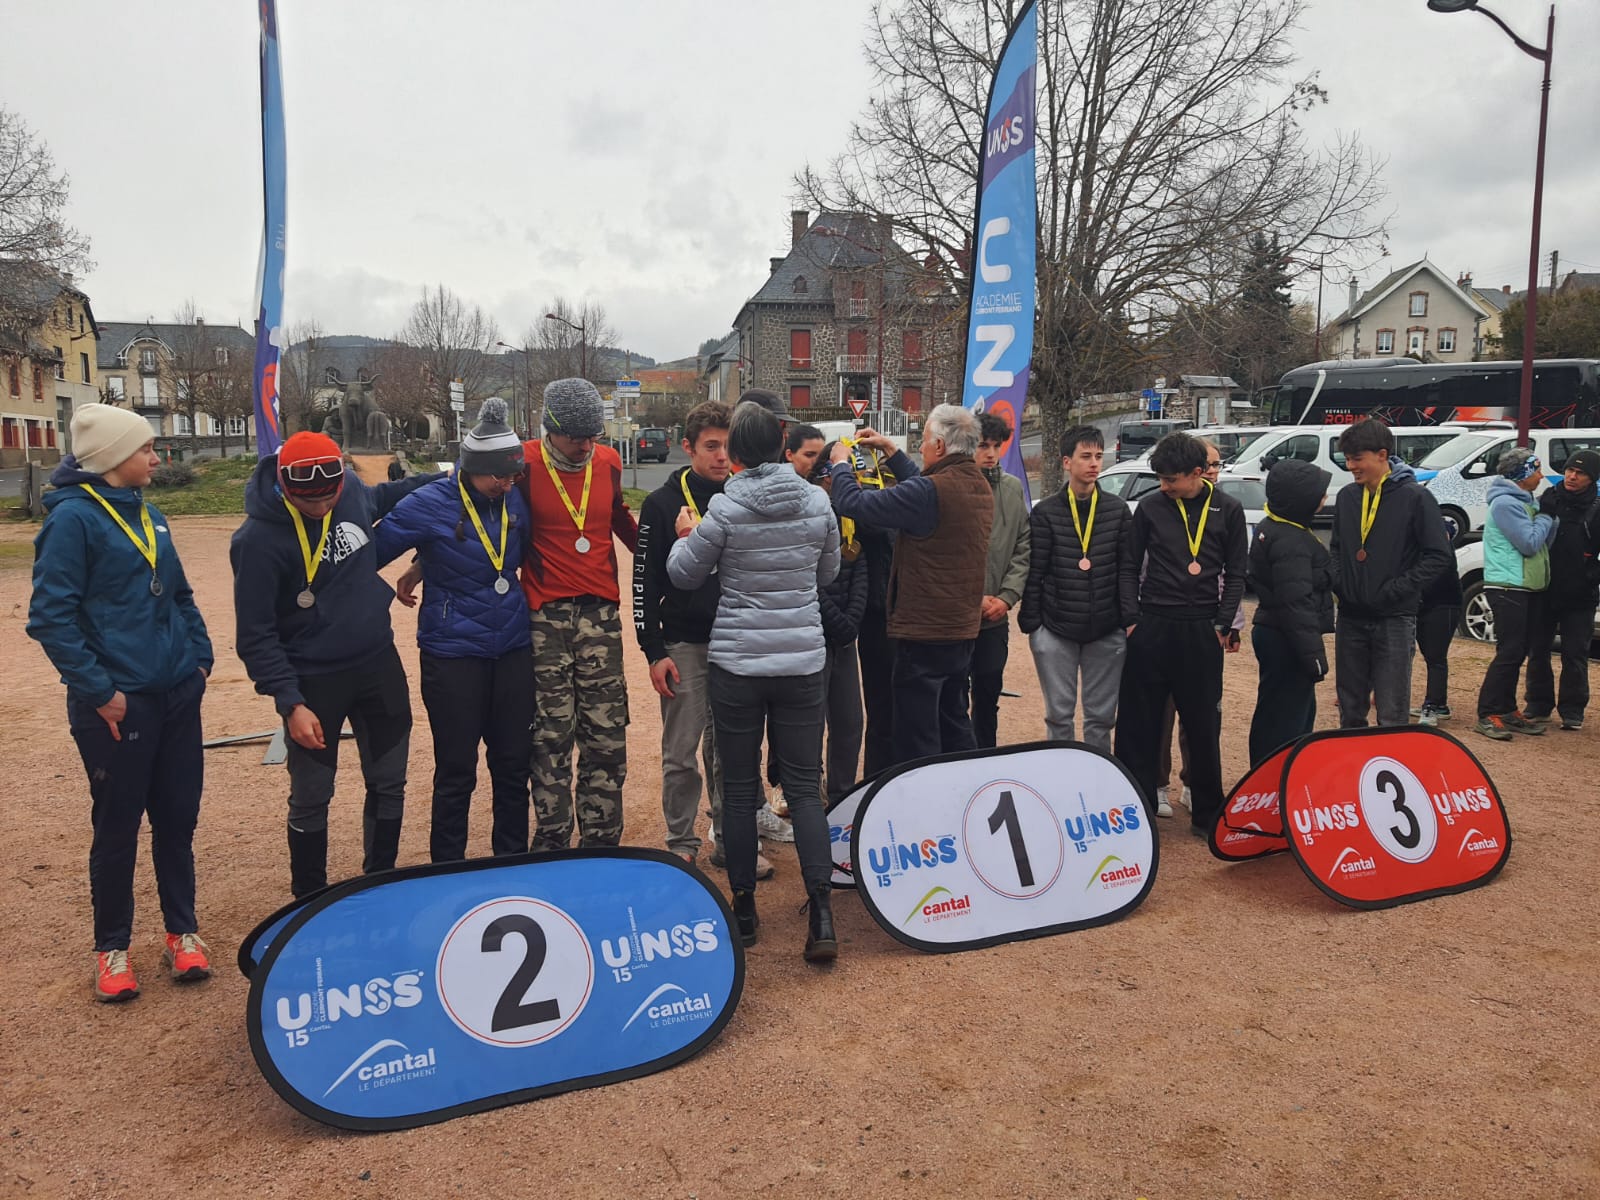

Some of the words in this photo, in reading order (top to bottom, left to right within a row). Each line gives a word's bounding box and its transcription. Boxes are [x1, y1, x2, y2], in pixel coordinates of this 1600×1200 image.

[987, 115, 1024, 158] UNSS
[633, 523, 651, 631] NUTRIPURE
[1376, 770, 1421, 848] 3
[1433, 788, 1491, 815] UNSS
[1064, 807, 1139, 841] UNSS
[1294, 804, 1359, 833] UNSS
[1444, 815, 1455, 826] 15
[987, 790, 1035, 887] 1
[1074, 841, 1088, 853] 15
[1302, 834, 1314, 846] 15
[1467, 837, 1498, 851] cantal
[868, 838, 957, 873] UNSS
[1340, 857, 1376, 873] cantal
[876, 874, 892, 888] 15
[1100, 863, 1141, 882] cantal
[923, 895, 970, 916] cantal
[601, 922, 718, 968] UNSS
[480, 914, 561, 1033] 2
[612, 968, 632, 984] 15
[277, 974, 423, 1030] UNSS
[647, 993, 712, 1019] cantal
[649, 1020, 659, 1029] LE
[662, 1010, 713, 1026] DÉPARTEMENT
[286, 1029, 310, 1049] 15
[358, 1047, 436, 1081] cantal
[358, 1082, 370, 1093] LE
[373, 1067, 437, 1089] DÉPARTEMENT
